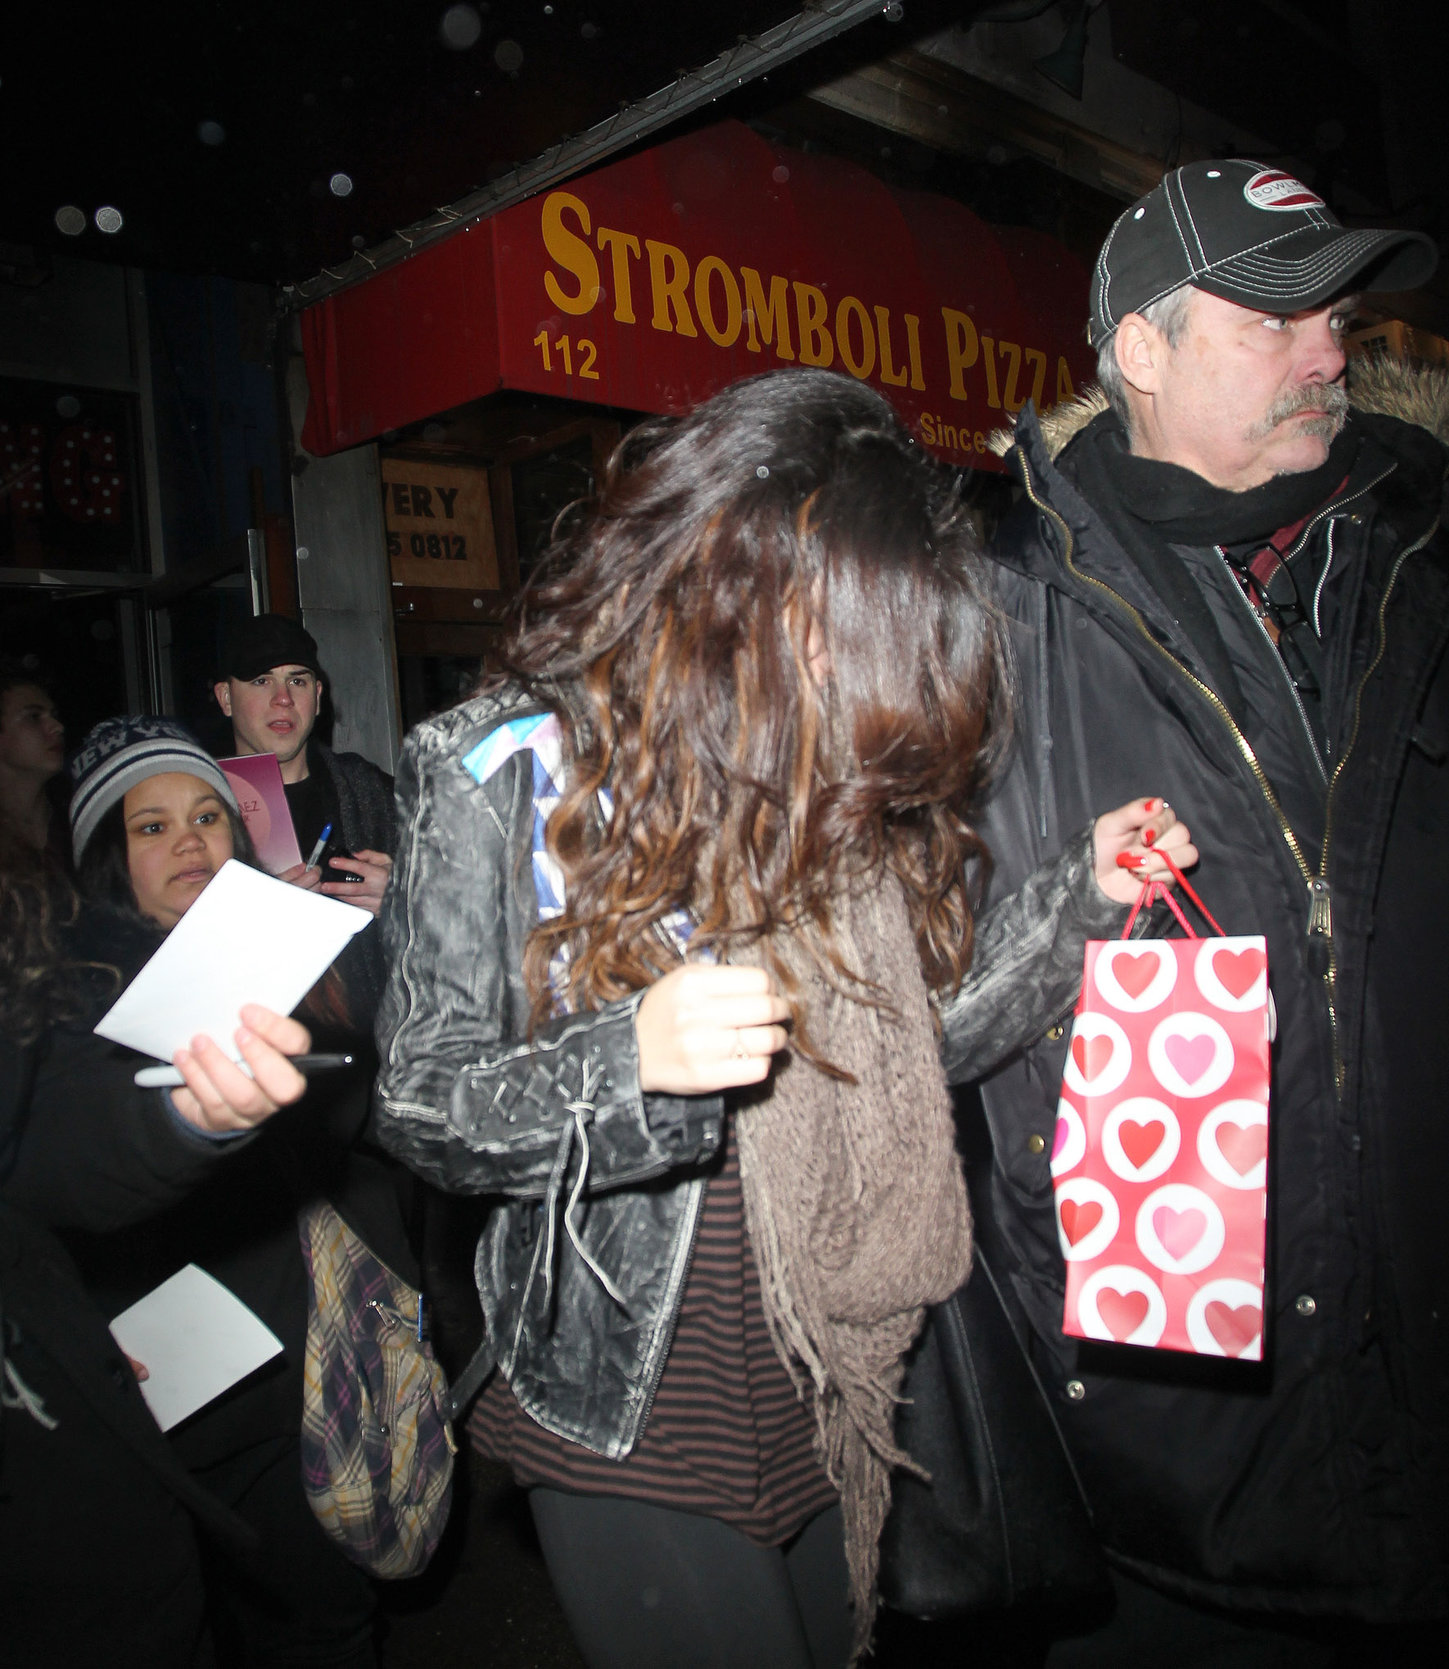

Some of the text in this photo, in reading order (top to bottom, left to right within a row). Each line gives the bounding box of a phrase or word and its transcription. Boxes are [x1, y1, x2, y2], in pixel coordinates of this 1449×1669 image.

[541, 190, 1075, 416] STROMBOLI PIZZA
[533, 329, 600, 381] 112
[920, 411, 986, 455] Since
[382, 482, 459, 519] ERY
[410, 533, 468, 561] 0812
